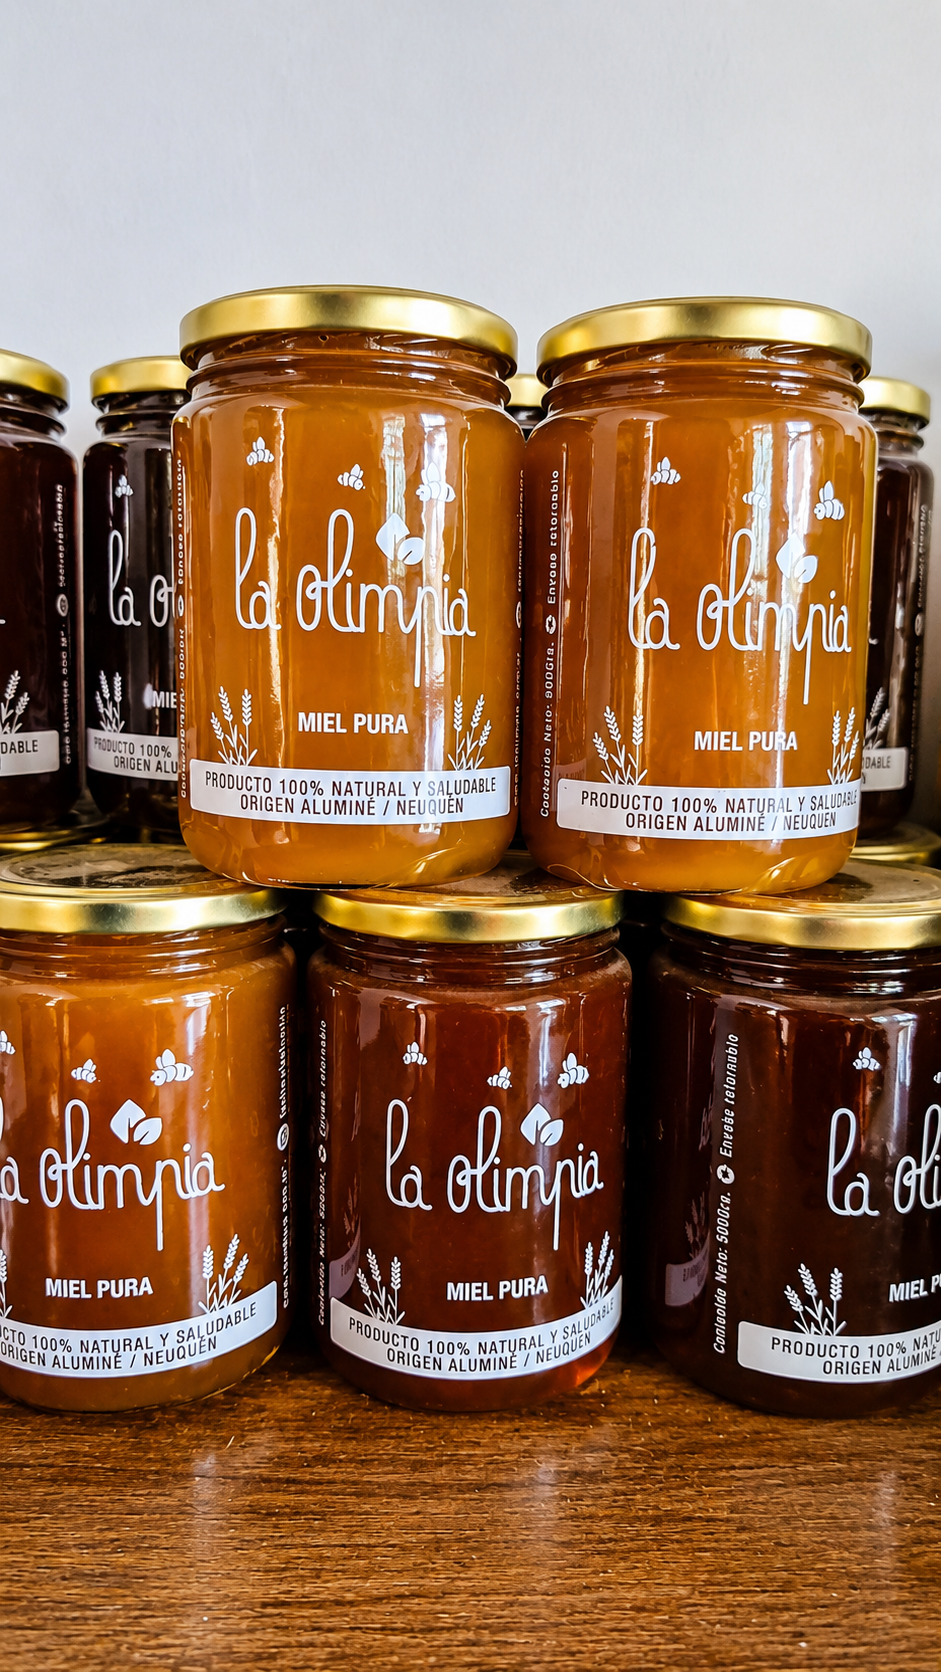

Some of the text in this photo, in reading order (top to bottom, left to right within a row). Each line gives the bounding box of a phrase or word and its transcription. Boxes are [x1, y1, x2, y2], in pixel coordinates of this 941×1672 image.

[107, 529, 142, 627] la
[235, 507, 282, 630] la
[296, 507, 476, 687] olimpia
[627, 526, 681, 650] la
[696, 527, 852, 705] olimpia
[297, 712, 409, 735] MIEL PURA
[0, 739, 39, 755] DABLE
[93, 736, 172, 759] PRODUCTO 100%
[693, 731, 798, 752] MIEL PURA
[113, 755, 151, 772] ORIGEN
[862, 755, 891, 770] DABLE
[205, 771, 496, 797] PRODUCTO 100% NATURAL Y SALUDABLE
[240, 794, 464, 816] ORIGEN ALUMINÉ / NEUQUÉN
[581, 789, 858, 814] PRODUCTO 100% NATURAL Y SALUDABLE
[625, 812, 688, 831] ORIGEN
[693, 813, 765, 832] ALUMINÉ
[771, 815, 778, 832] /
[827, 1107, 880, 1216] la
[39, 1099, 225, 1251] olimpia
[384, 1098, 433, 1211] la
[447, 1105, 604, 1251] olimpia
[45, 1276, 153, 1299] MIEL PURA
[446, 1275, 549, 1301] MIEL PURA
[888, 1279, 929, 1303] MIEL
[32, 1335, 72, 1353] 100%
[80, 1336, 154, 1354] NATURAL
[160, 1332, 169, 1347] Y
[176, 1302, 257, 1344] SALUDABLE
[349, 1297, 614, 1356] PRODUCTO 100% NATURAL Y SALUDABLE
[0, 1334, 217, 1370] ORIGEN ALUMINÉ / NEUQUÉN
[387, 1348, 442, 1371] ORIGEN
[523, 1353, 530, 1367] /
[771, 1336, 860, 1359] PRODUCTO
[868, 1341, 907, 1358] 100%
[823, 1360, 881, 1375] ORIGEN
